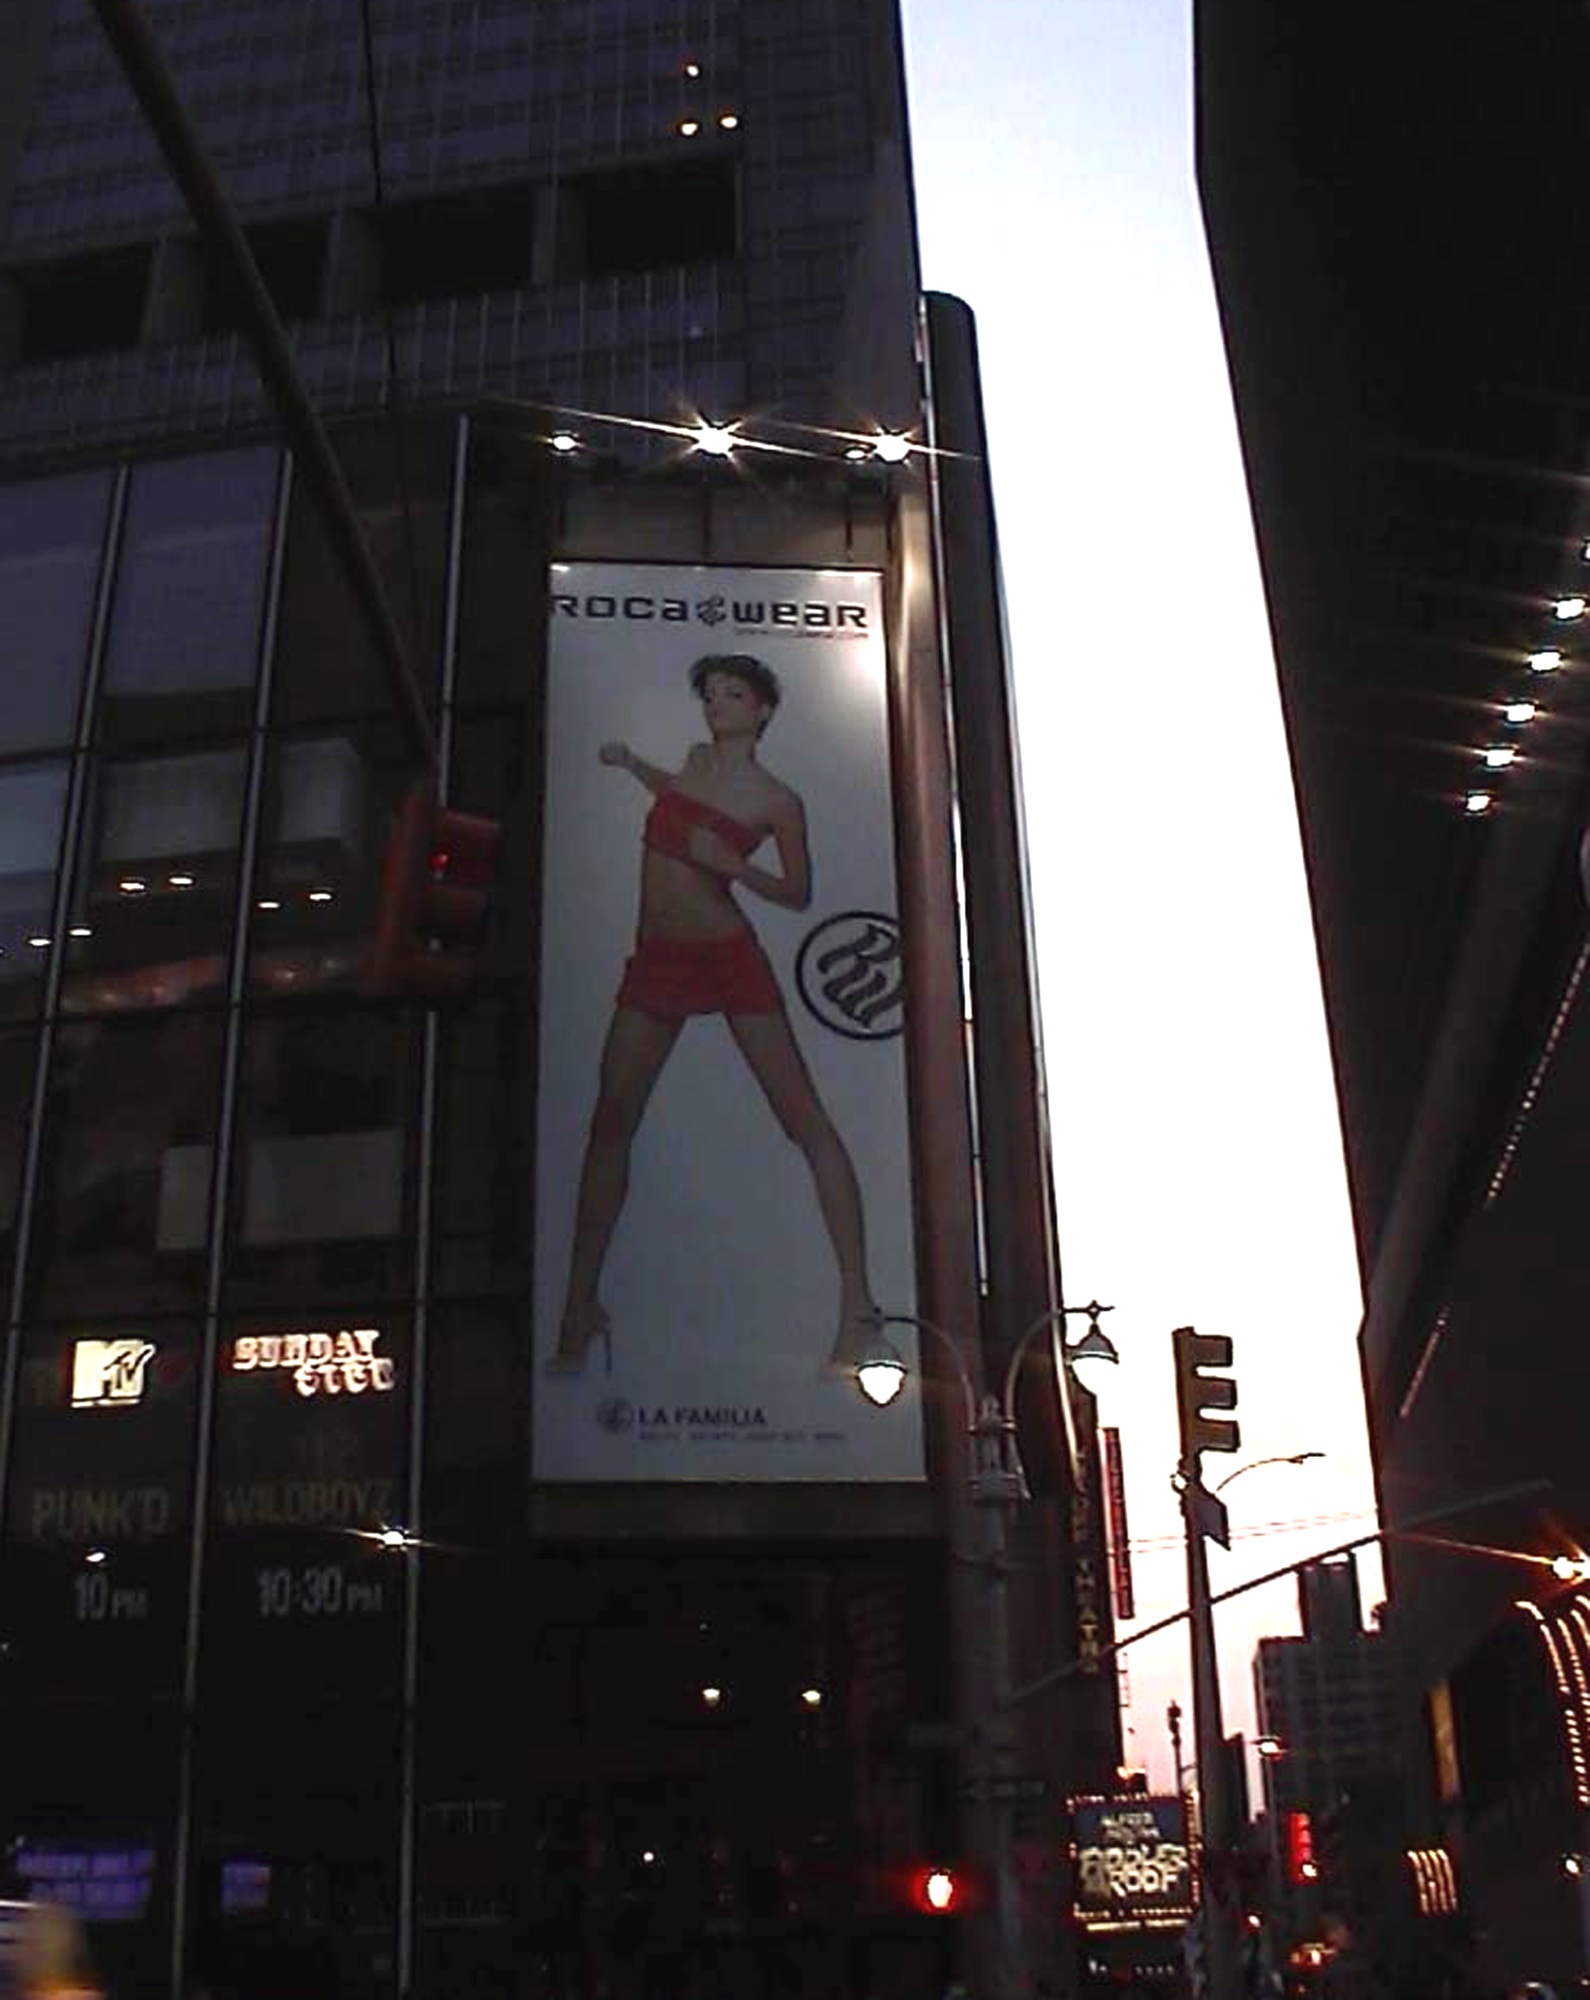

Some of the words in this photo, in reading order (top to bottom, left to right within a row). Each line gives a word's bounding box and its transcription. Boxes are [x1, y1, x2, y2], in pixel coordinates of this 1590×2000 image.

[73, 1339, 155, 1399] MTV
[233, 1330, 380, 1369] SUNDAY
[639, 1407, 668, 1425] LA
[675, 1407, 767, 1426] FAMILIA
[32, 1485, 169, 1538] PUNK'D
[75, 1574, 109, 1620] 10
[257, 1565, 342, 1618] 10:30
